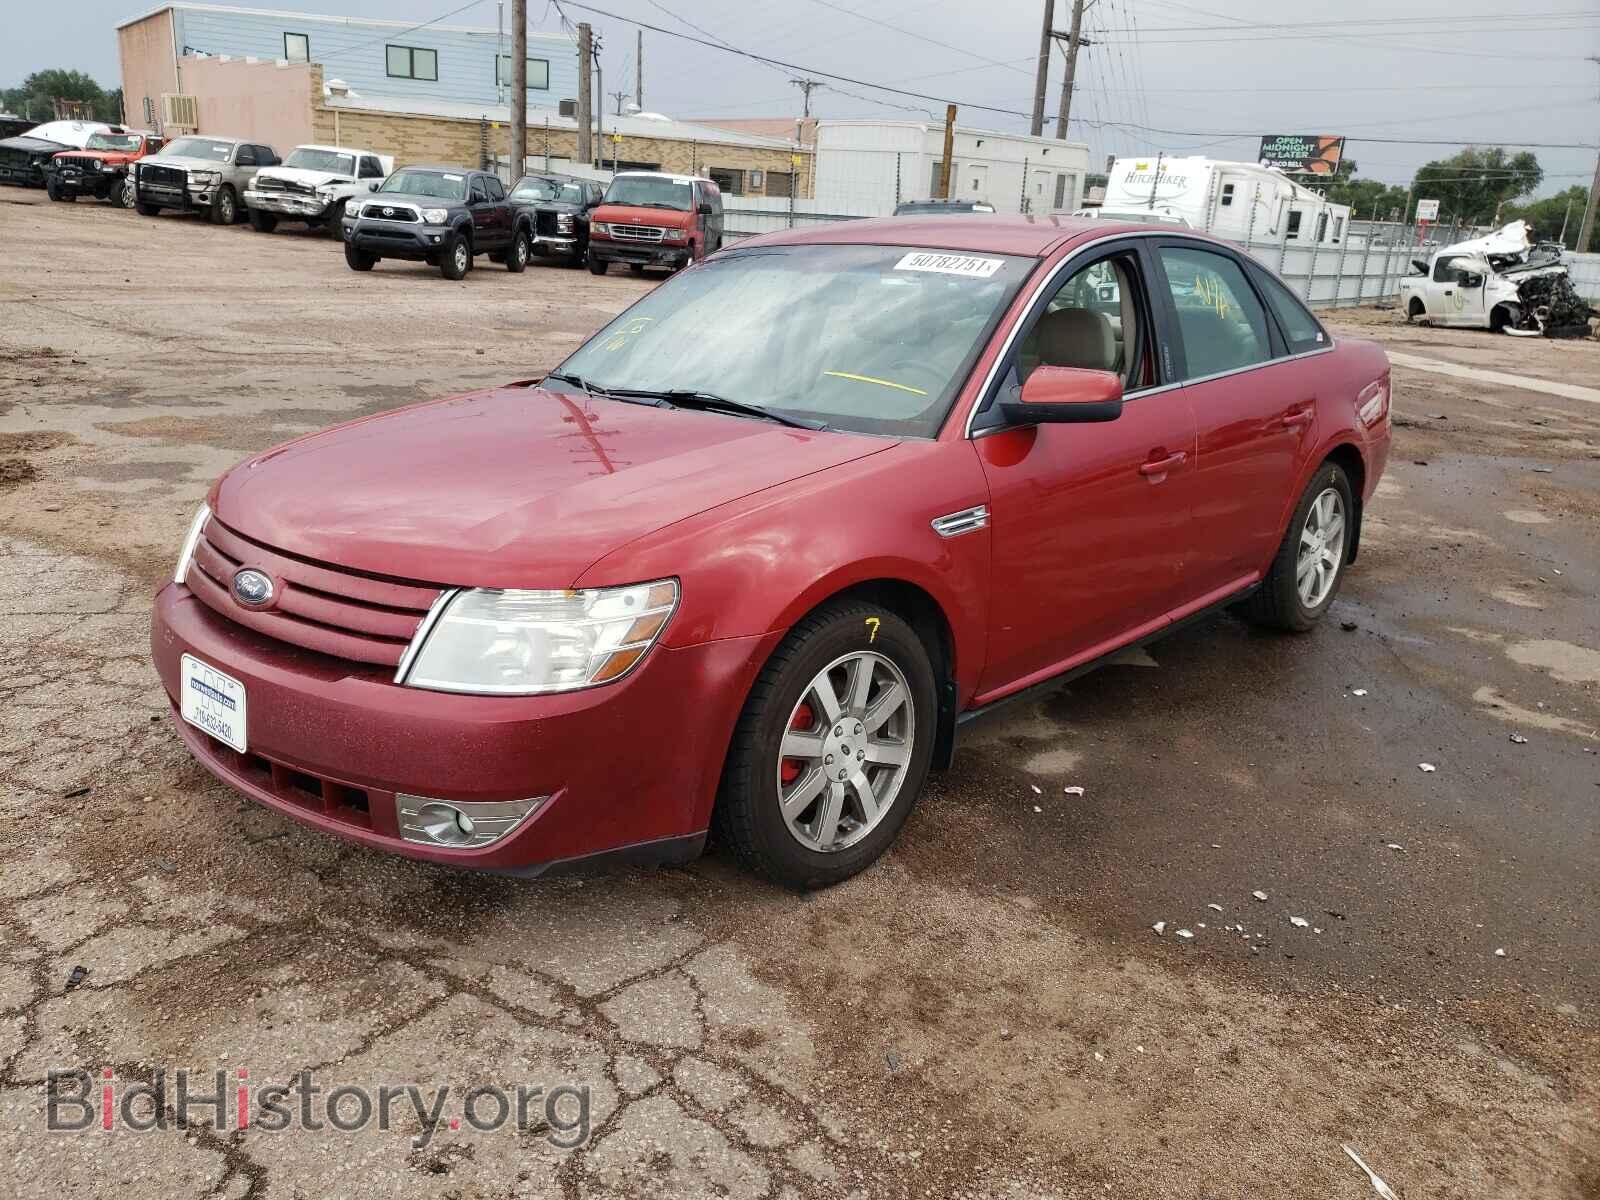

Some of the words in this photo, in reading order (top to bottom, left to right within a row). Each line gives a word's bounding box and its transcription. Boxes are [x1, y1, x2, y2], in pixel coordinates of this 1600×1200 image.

[1276, 137, 1303, 145] OPEN
[1263, 143, 1315, 152] MIDNIGHT
[865, 617, 880, 643] 7
